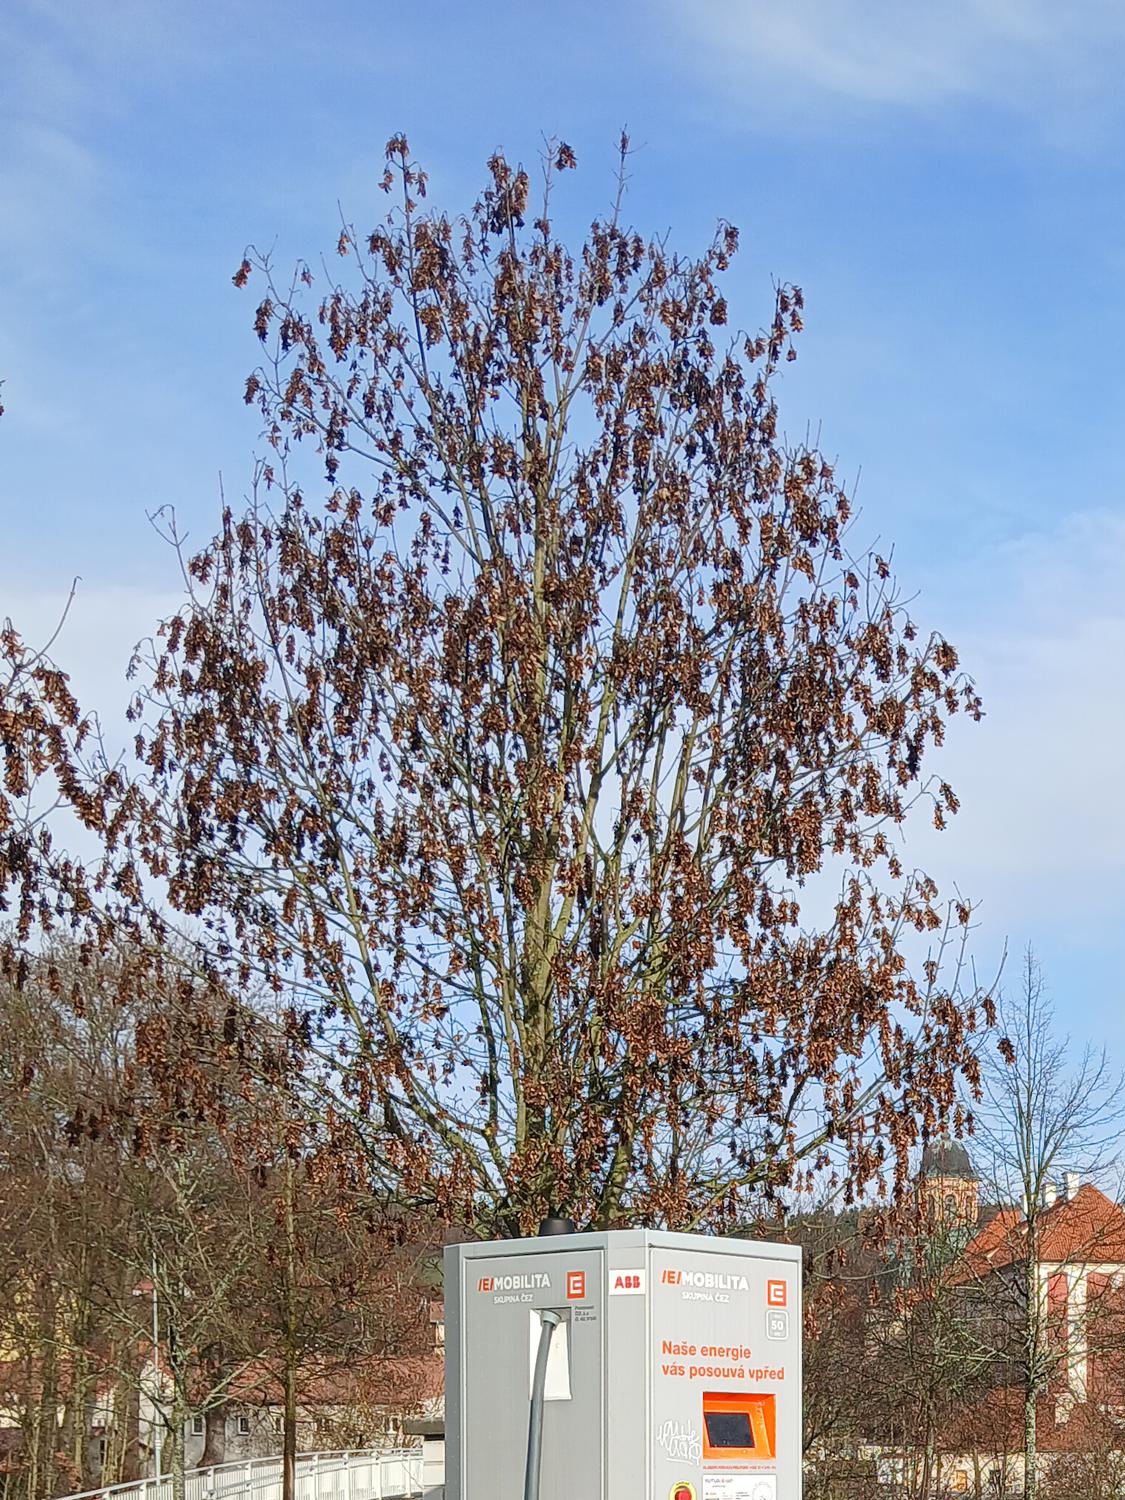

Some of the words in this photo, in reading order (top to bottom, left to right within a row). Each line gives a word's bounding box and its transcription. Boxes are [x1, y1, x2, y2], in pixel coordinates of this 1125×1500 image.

[615, 1276, 640, 1289] ABB
[714, 1293, 729, 1303] ČEZ
[771, 1320, 784, 1331] 50
[661, 1340, 697, 1356] Naše
[700, 1345, 751, 1361] energie
[661, 1362, 686, 1376] vás
[689, 1365, 745, 1379] posouvá
[748, 1366, 785, 1382] vpřed
